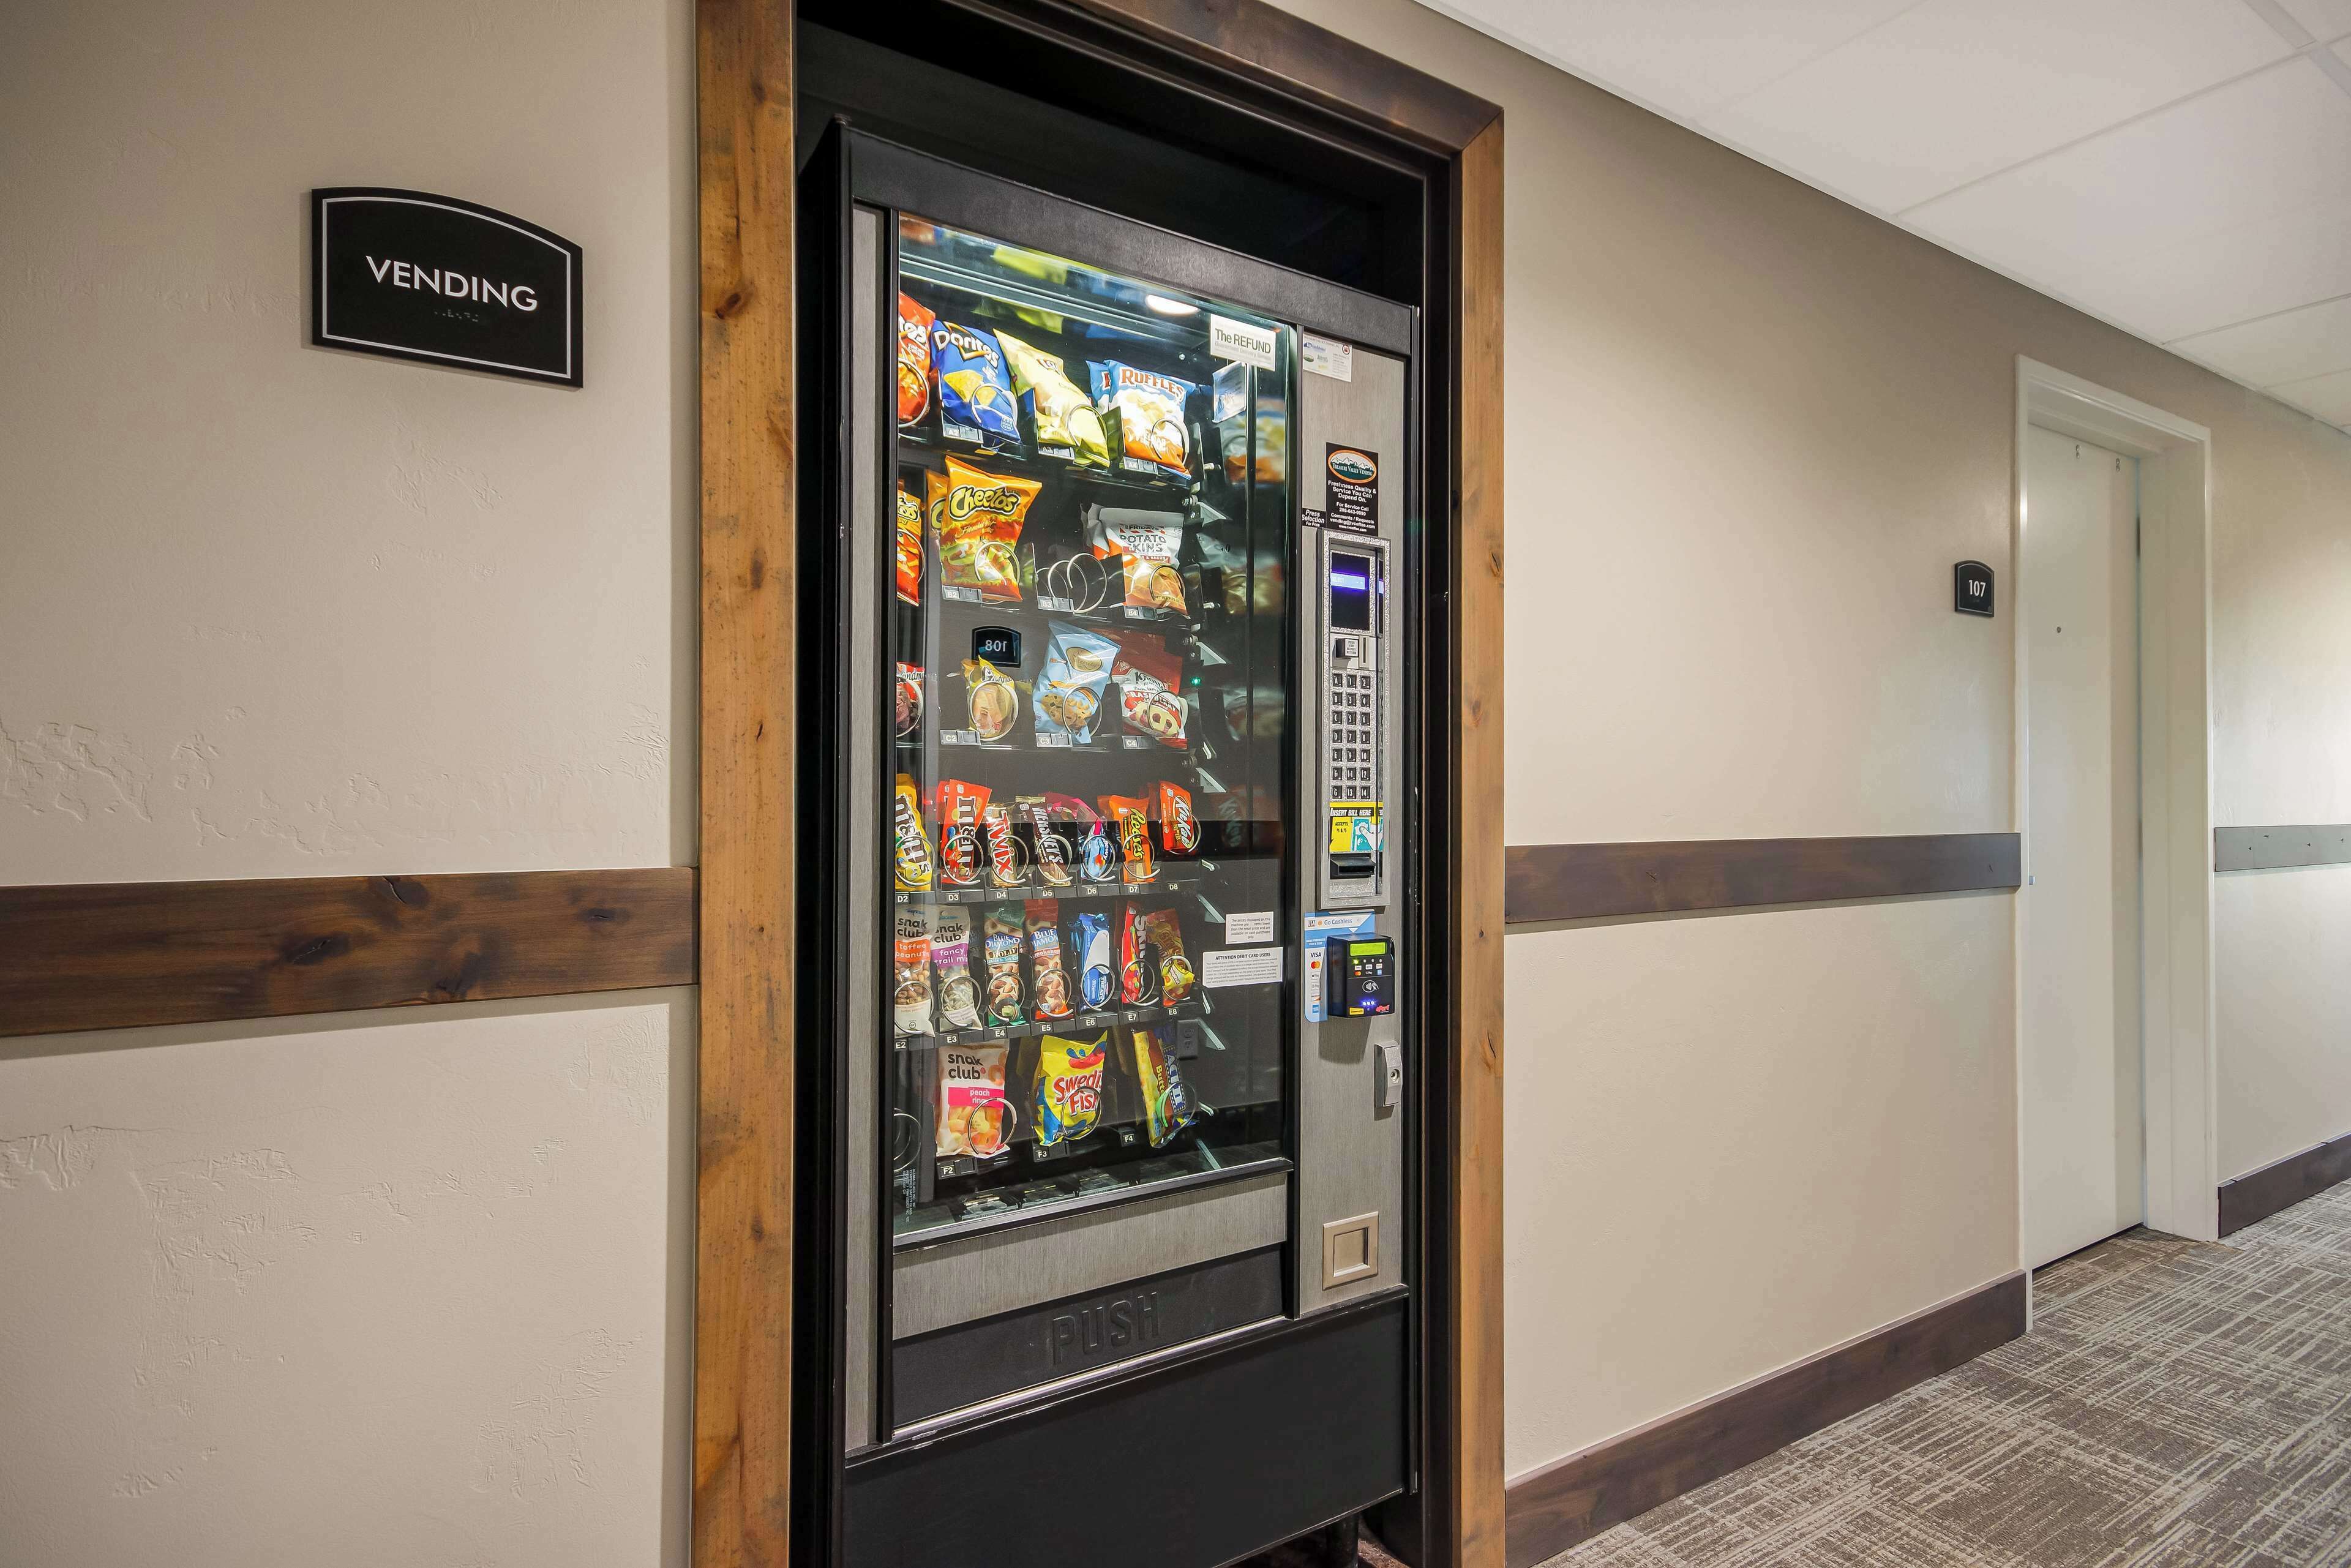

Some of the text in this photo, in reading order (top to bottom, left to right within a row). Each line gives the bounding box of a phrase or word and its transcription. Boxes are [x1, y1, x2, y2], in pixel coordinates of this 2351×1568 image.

[366, 255, 538, 311] VENDING
[1215, 328, 1271, 354] The REFUND
[934, 331, 999, 368] Doritos
[1122, 368, 1185, 400] RUFFLES
[1328, 480, 1354, 489] Freshness
[950, 487, 1018, 518] Cheetos
[1302, 514, 1325, 523] Selection
[1119, 535, 1166, 543] POTATO
[1127, 543, 1163, 552] KINS
[1969, 579, 1986, 597] 107
[1330, 808, 1348, 816] INSERT
[1130, 808, 1147, 859] Reese's
[986, 811, 1013, 876] TWIX
[898, 918, 928, 929] snak
[897, 928, 925, 938] club
[934, 933, 962, 943] club
[1034, 929, 1056, 940] BLUE
[985, 937, 1020, 948] DIAMOND
[939, 947, 964, 956] fancy
[934, 956, 953, 966] trail
[948, 1053, 984, 1066] snak
[948, 1065, 981, 1079] club
[1053, 1069, 1102, 1103] Swedi
[1156, 1064, 1165, 1097] Butte
[1052, 1292, 1159, 1365] PUSH
